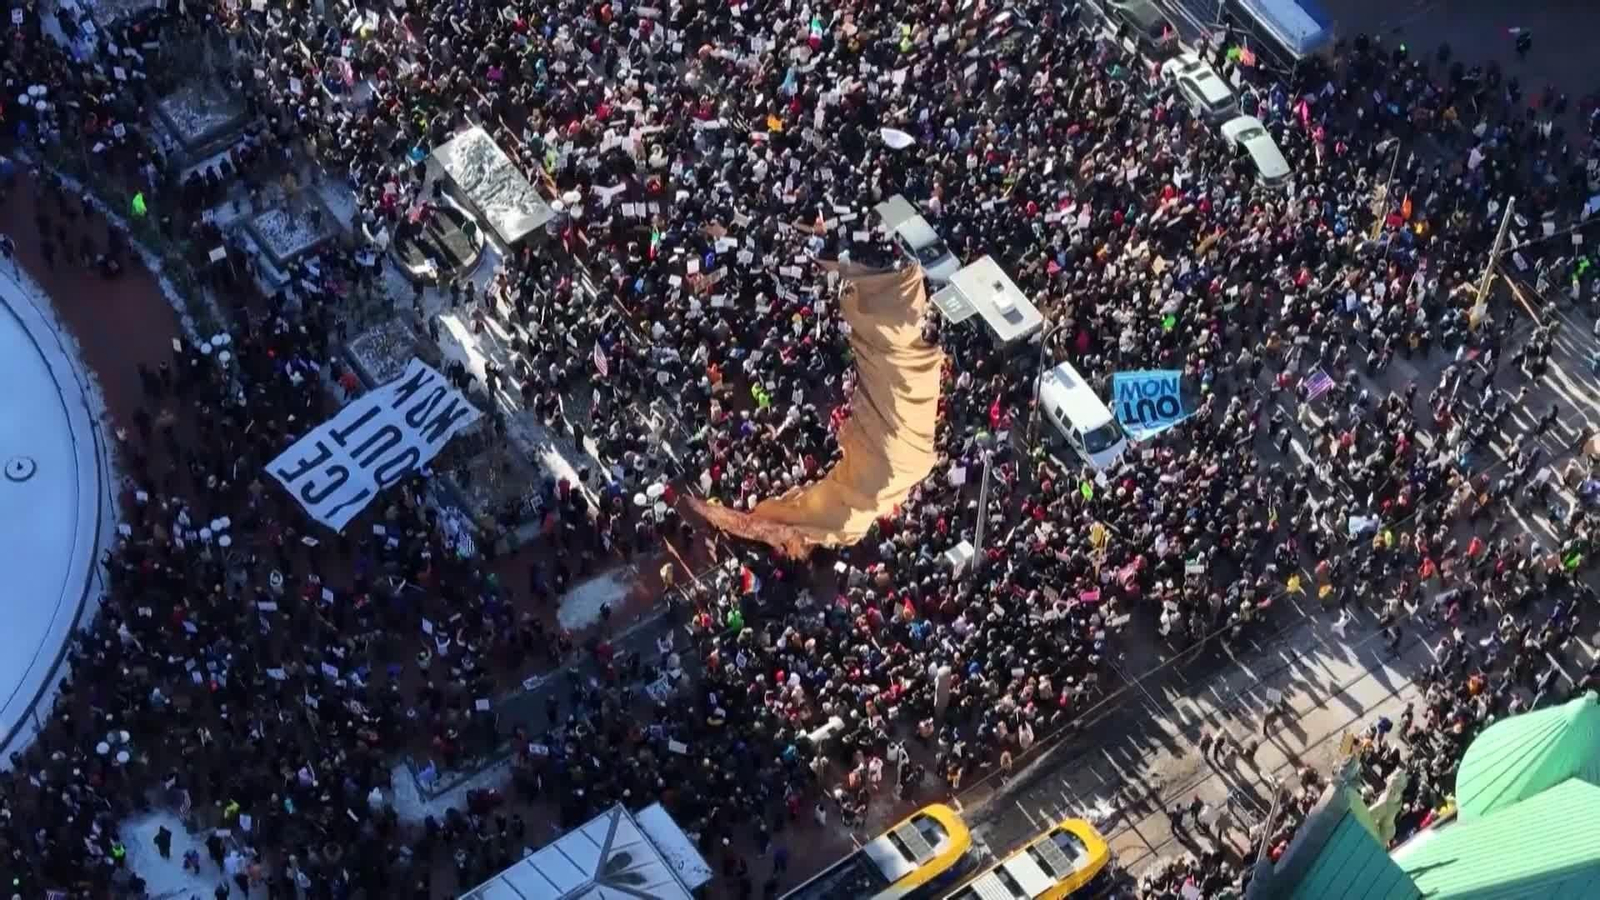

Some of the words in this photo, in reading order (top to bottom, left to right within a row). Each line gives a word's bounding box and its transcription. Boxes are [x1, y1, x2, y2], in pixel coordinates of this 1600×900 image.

[1119, 378, 1177, 401] NOW
[1123, 395, 1180, 428] OUT
[329, 405, 421, 487] OUT
[277, 440, 370, 519] ICE
